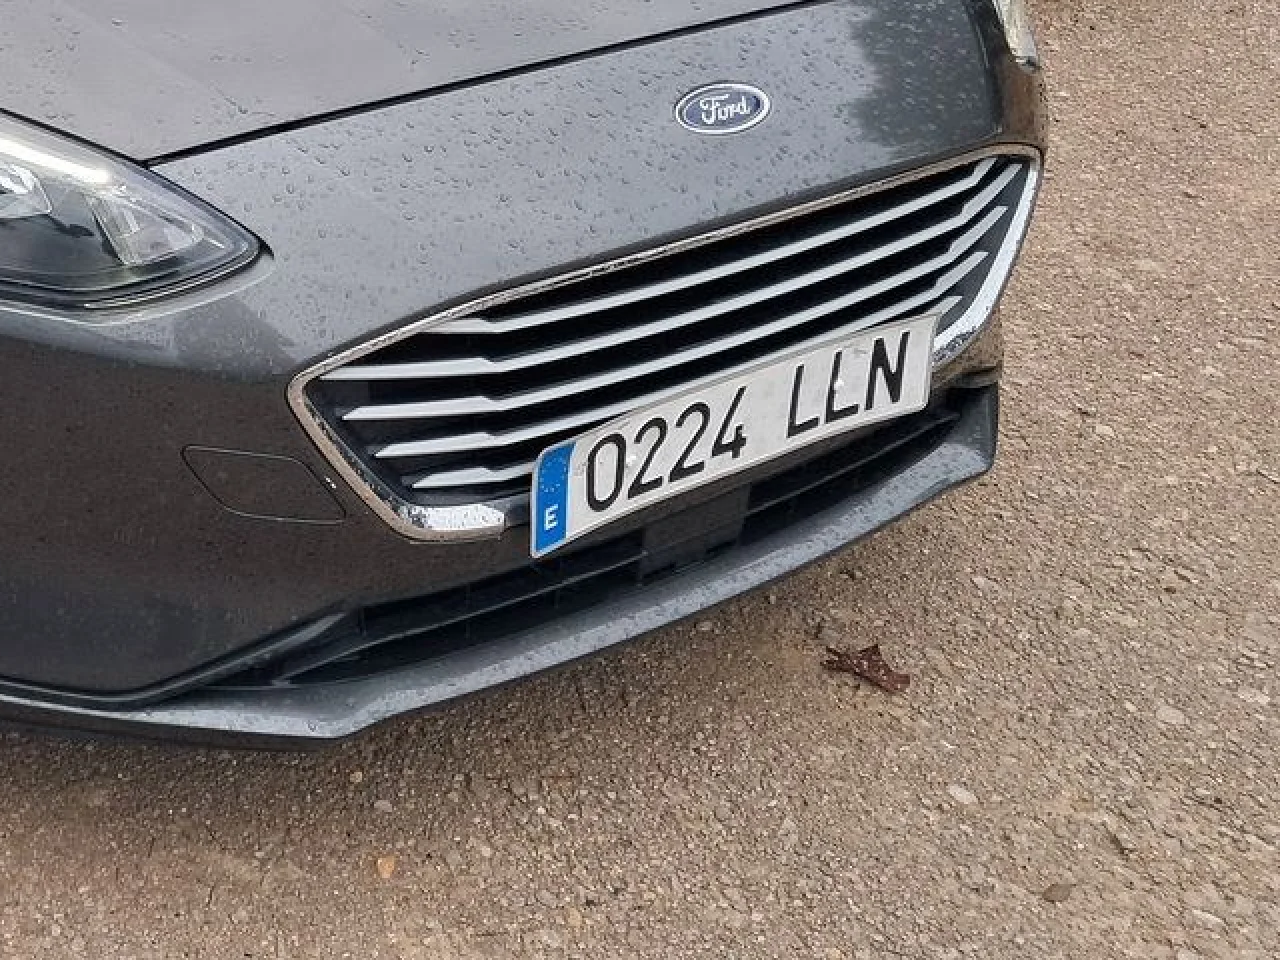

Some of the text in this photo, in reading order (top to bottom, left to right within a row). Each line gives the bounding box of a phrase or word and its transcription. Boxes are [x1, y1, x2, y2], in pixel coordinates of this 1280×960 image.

[700, 93, 751, 125] Ford
[543, 331, 910, 531] E 0224 LLN
